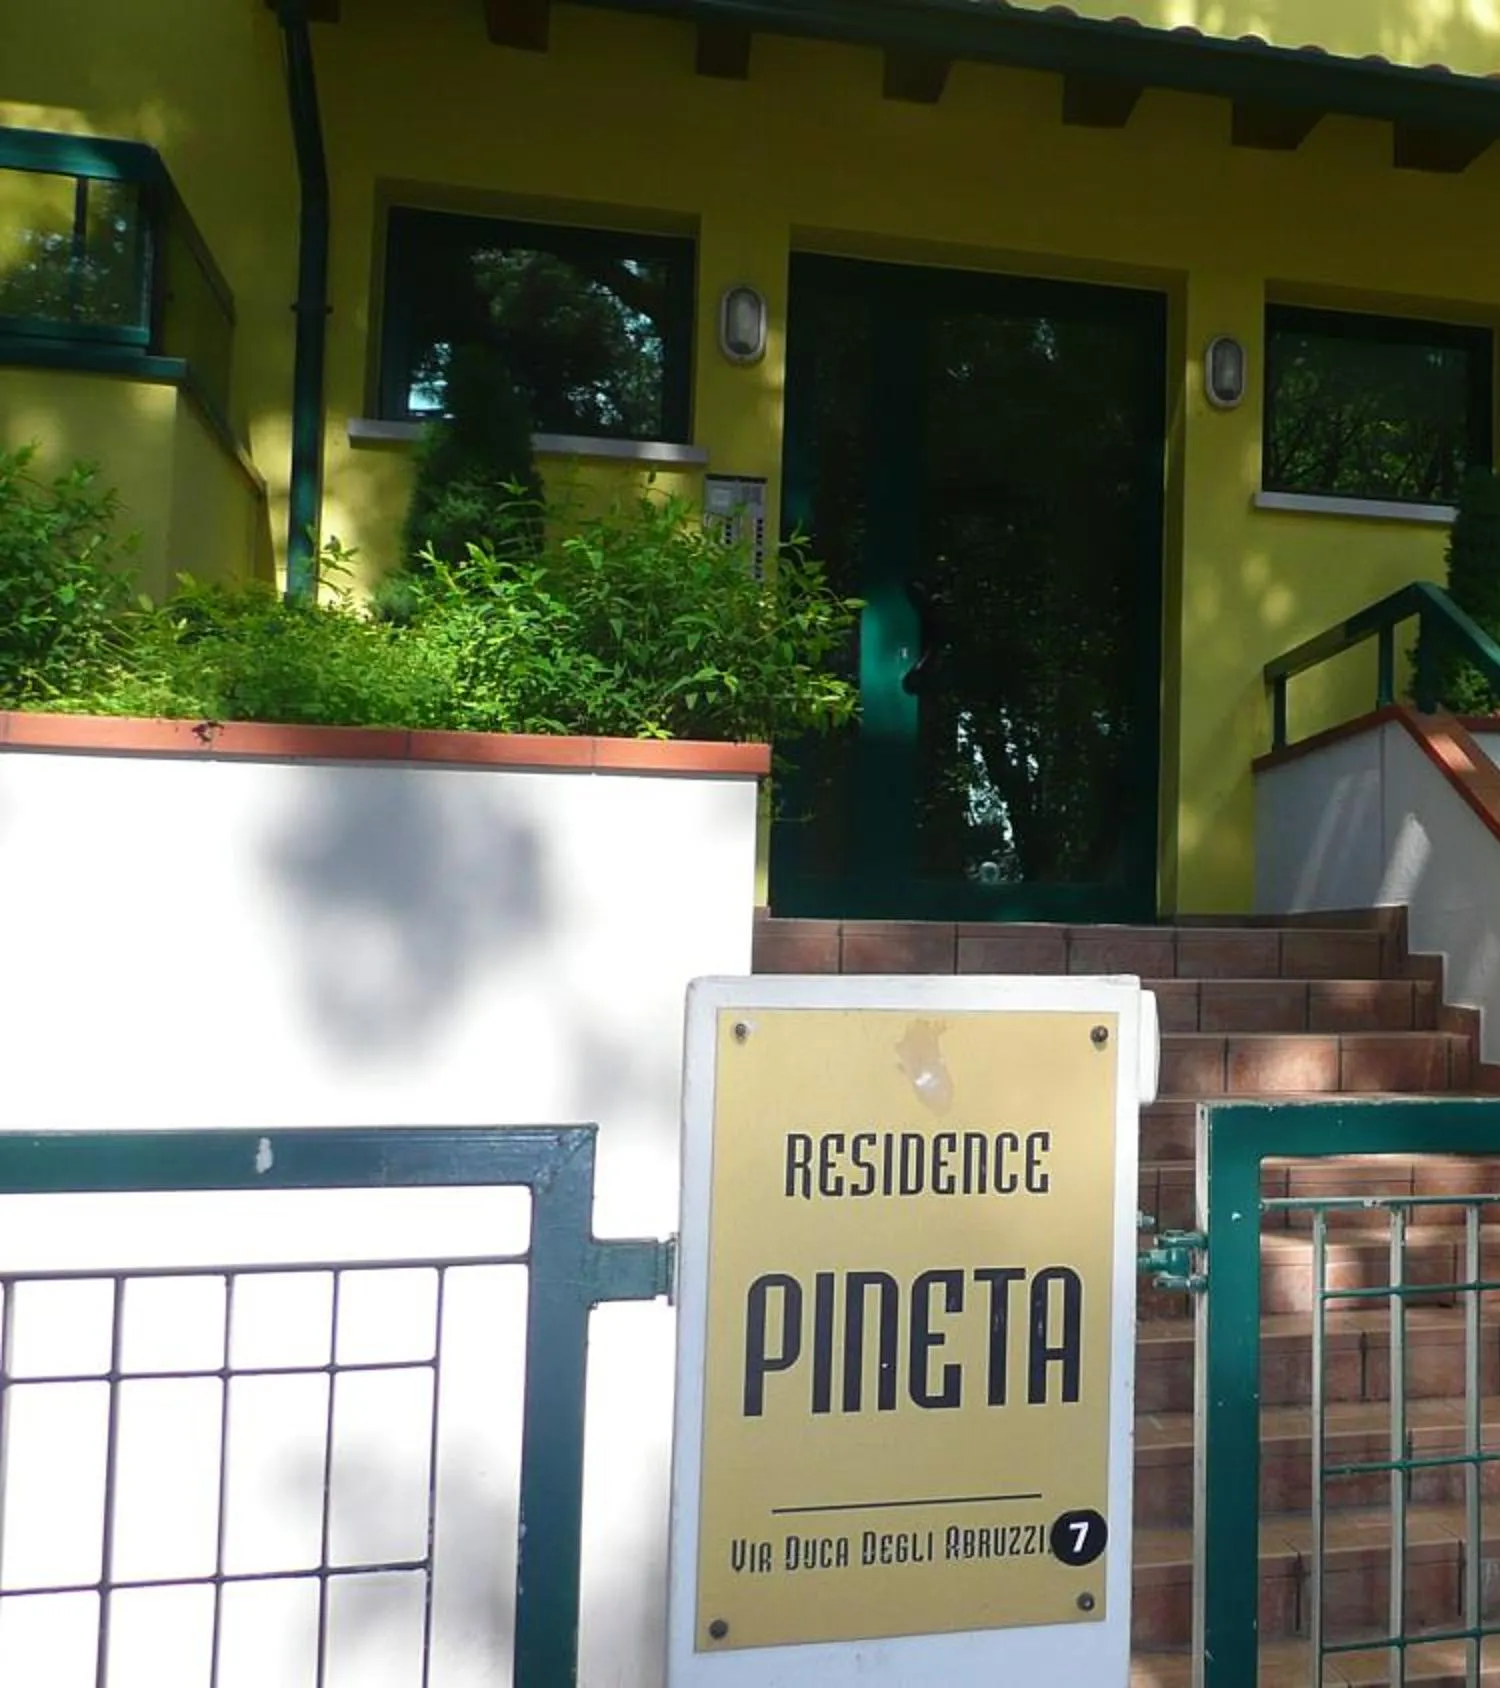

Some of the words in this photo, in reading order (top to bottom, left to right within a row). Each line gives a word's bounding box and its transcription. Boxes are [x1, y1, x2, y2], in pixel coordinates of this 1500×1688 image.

[785, 1132, 1050, 1200] RESIDENCE
[744, 1266, 1083, 1416] PINETA
[1069, 1521, 1089, 1553] 7
